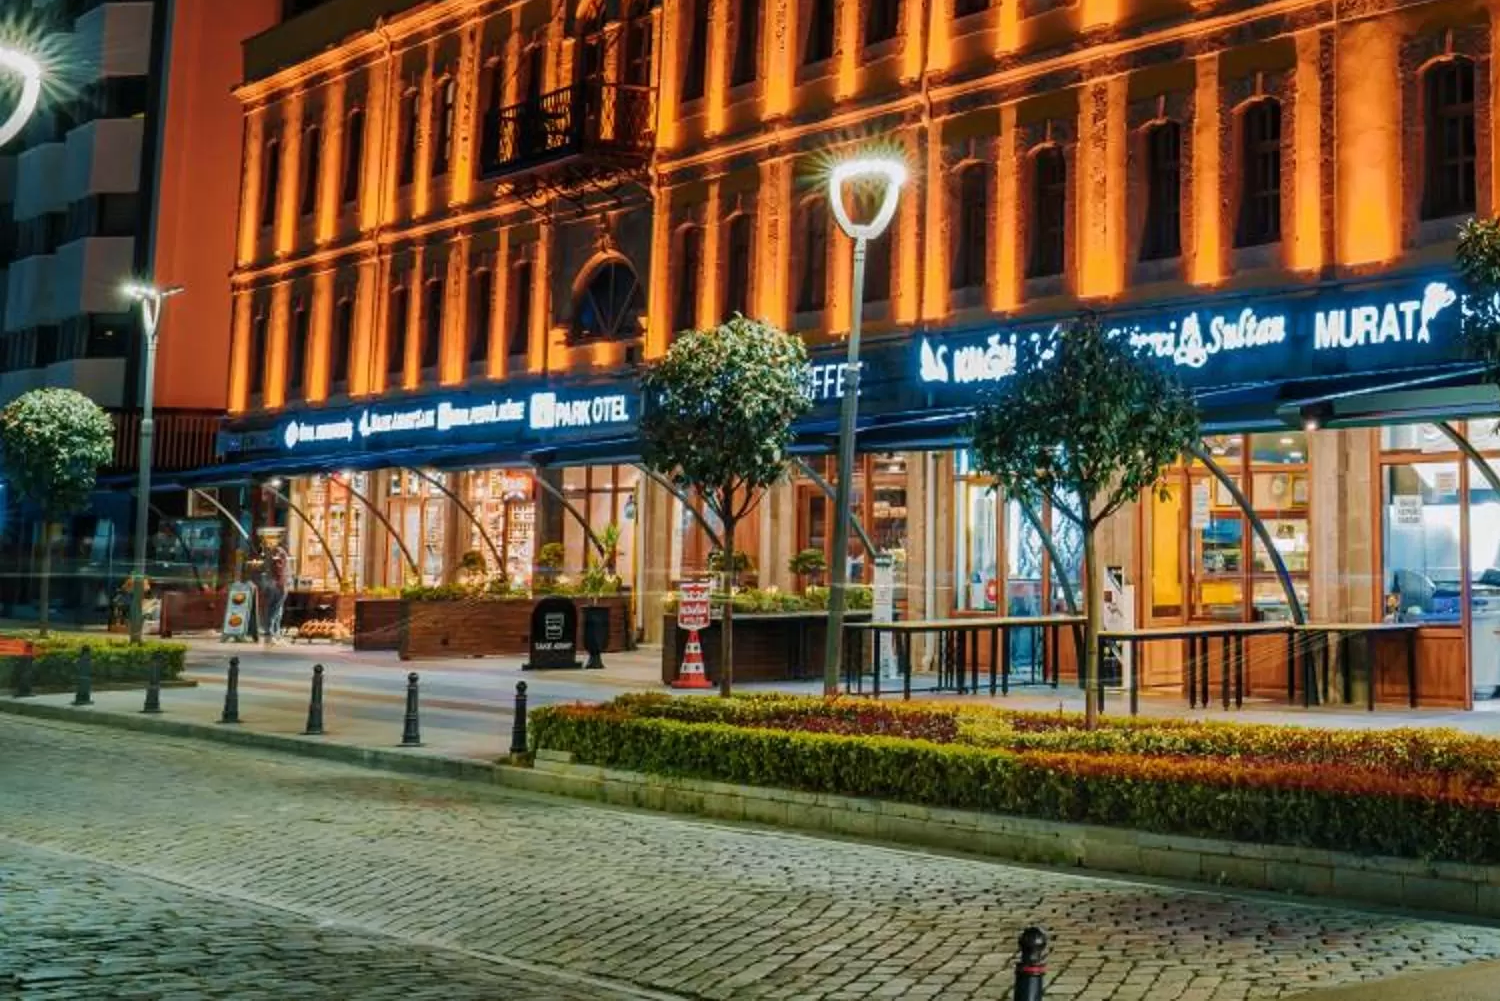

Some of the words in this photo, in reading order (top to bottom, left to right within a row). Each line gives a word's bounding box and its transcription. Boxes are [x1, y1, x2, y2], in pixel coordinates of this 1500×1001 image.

[1206, 307, 1286, 354] Sultan
[1314, 301, 1420, 350] MURAT
[554, 400, 591, 427] PARK
[592, 395, 629, 423] OTEL
